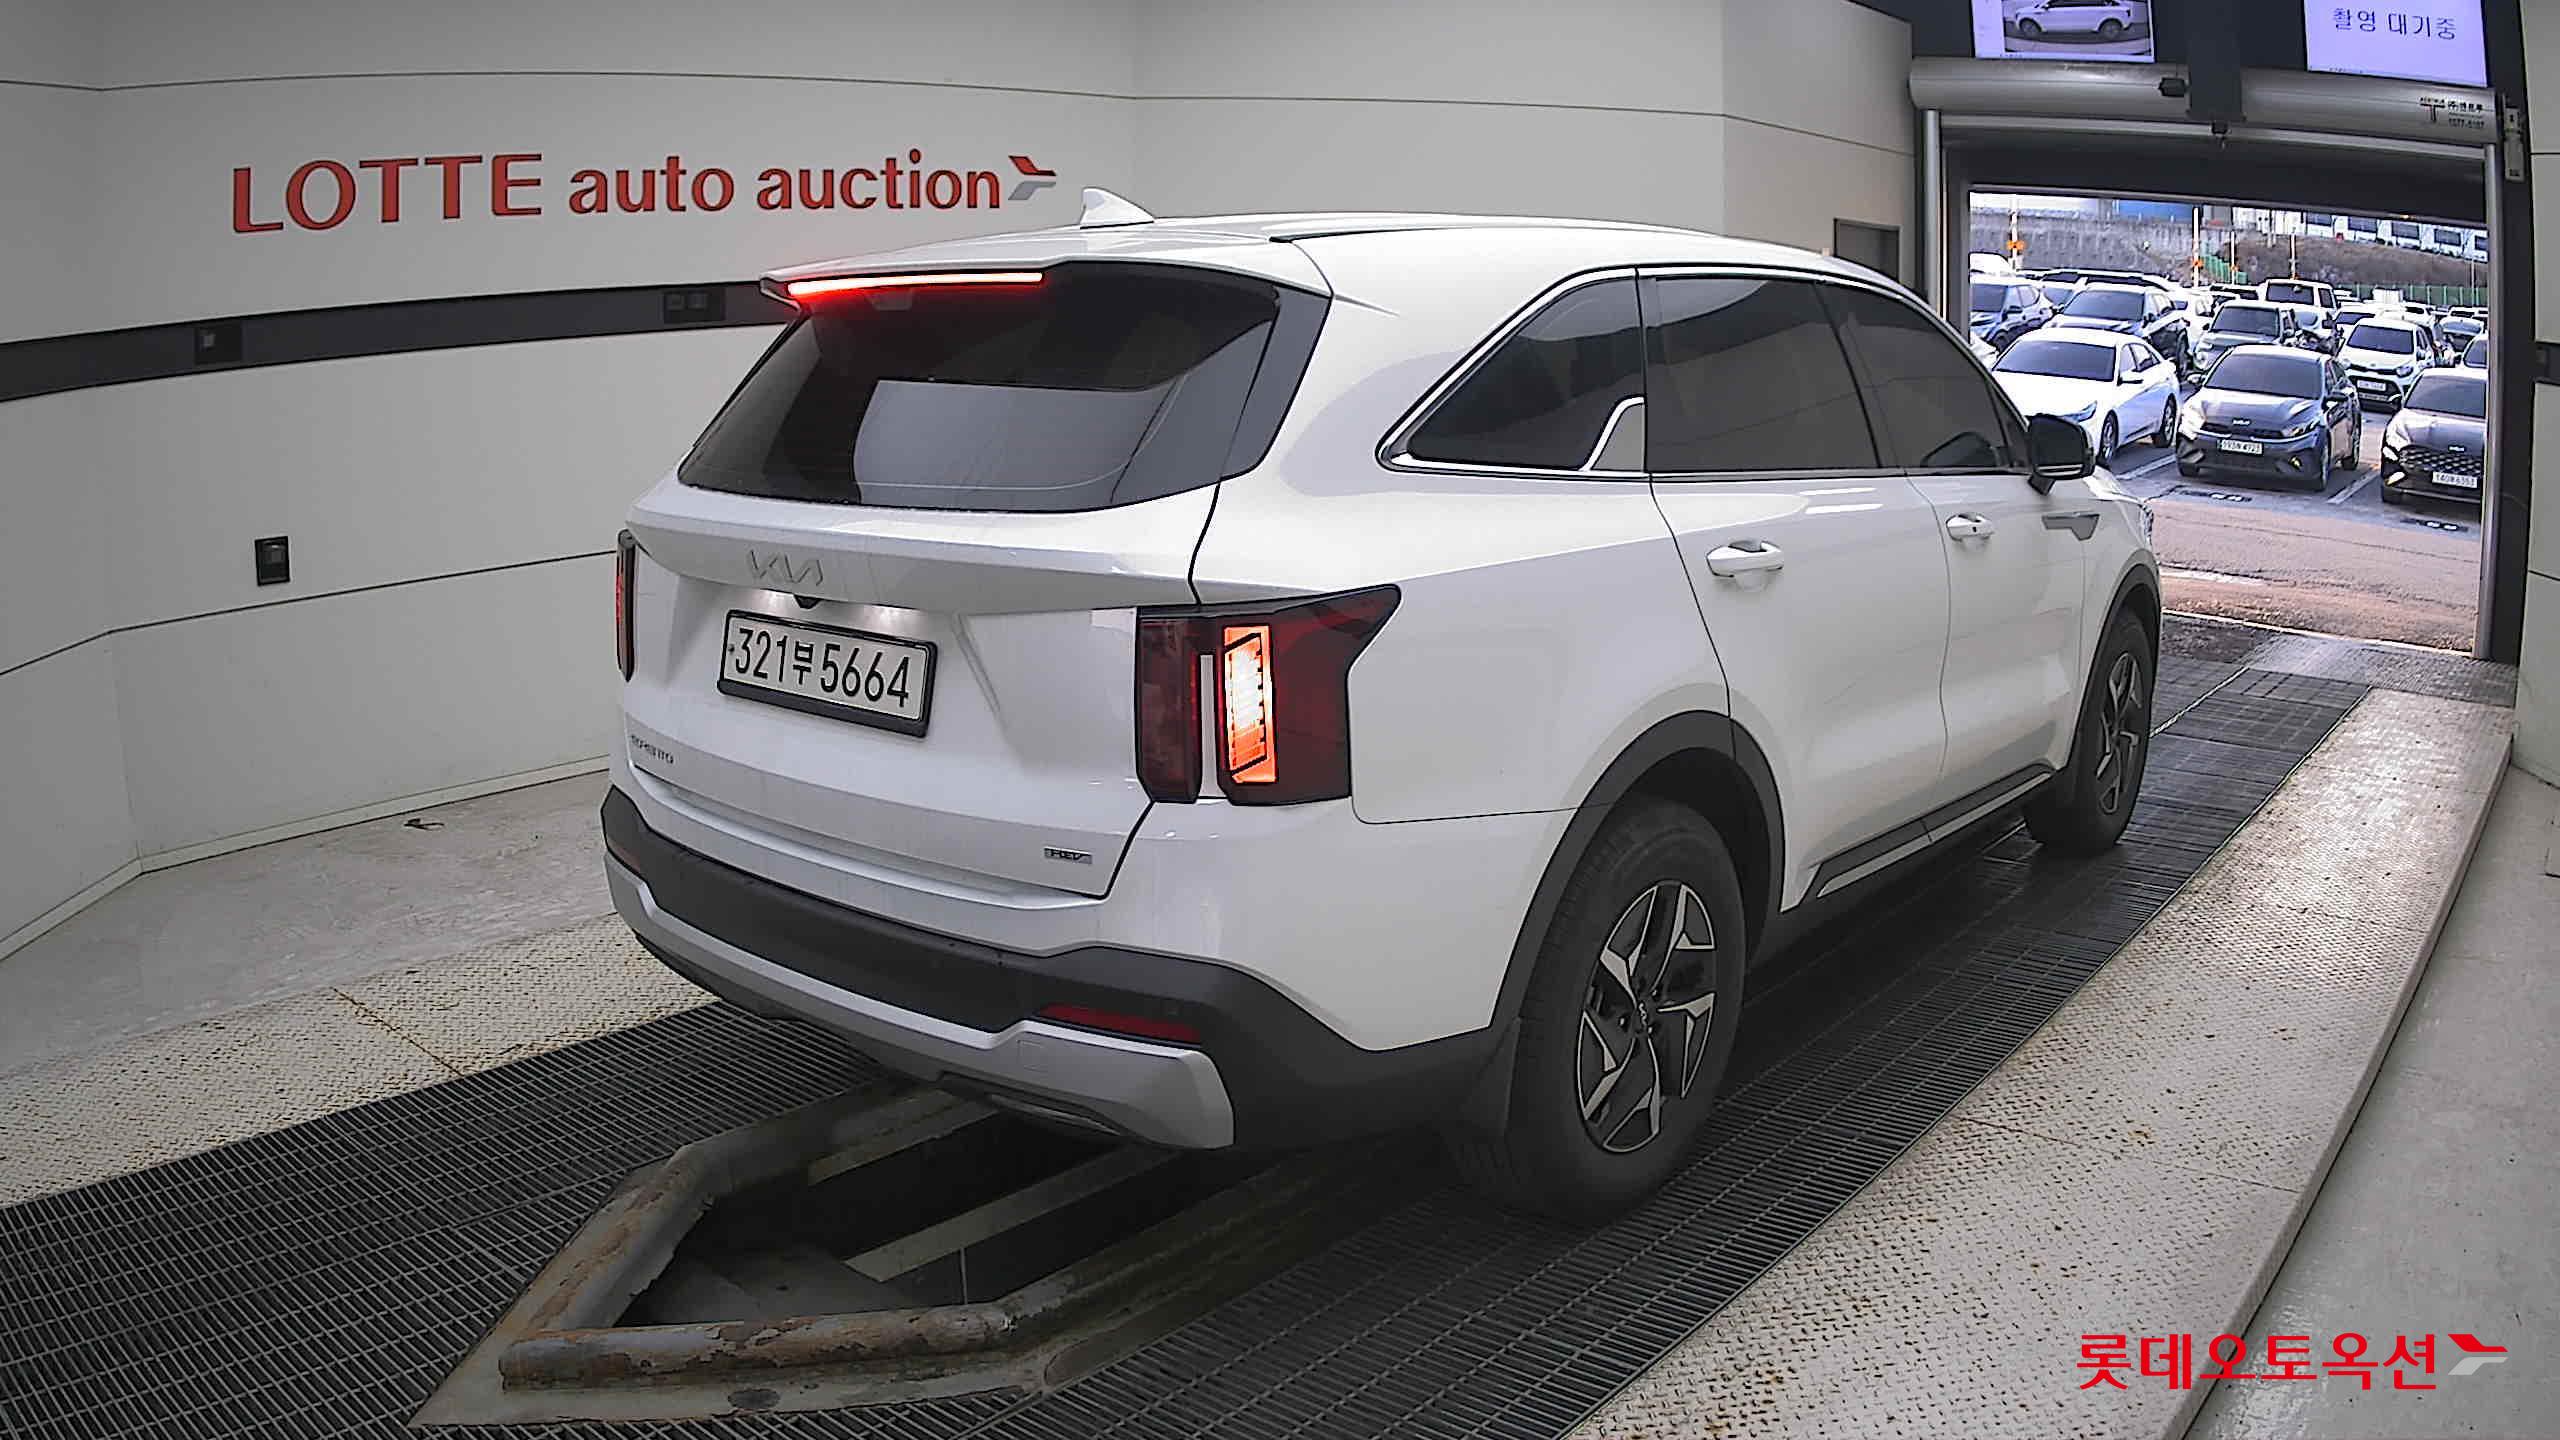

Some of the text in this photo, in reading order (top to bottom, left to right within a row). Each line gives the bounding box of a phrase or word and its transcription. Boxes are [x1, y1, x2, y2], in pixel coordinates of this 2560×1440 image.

[2388, 13, 2456, 40] 대기중
[232, 147, 1003, 235] LOTTE auto auction
